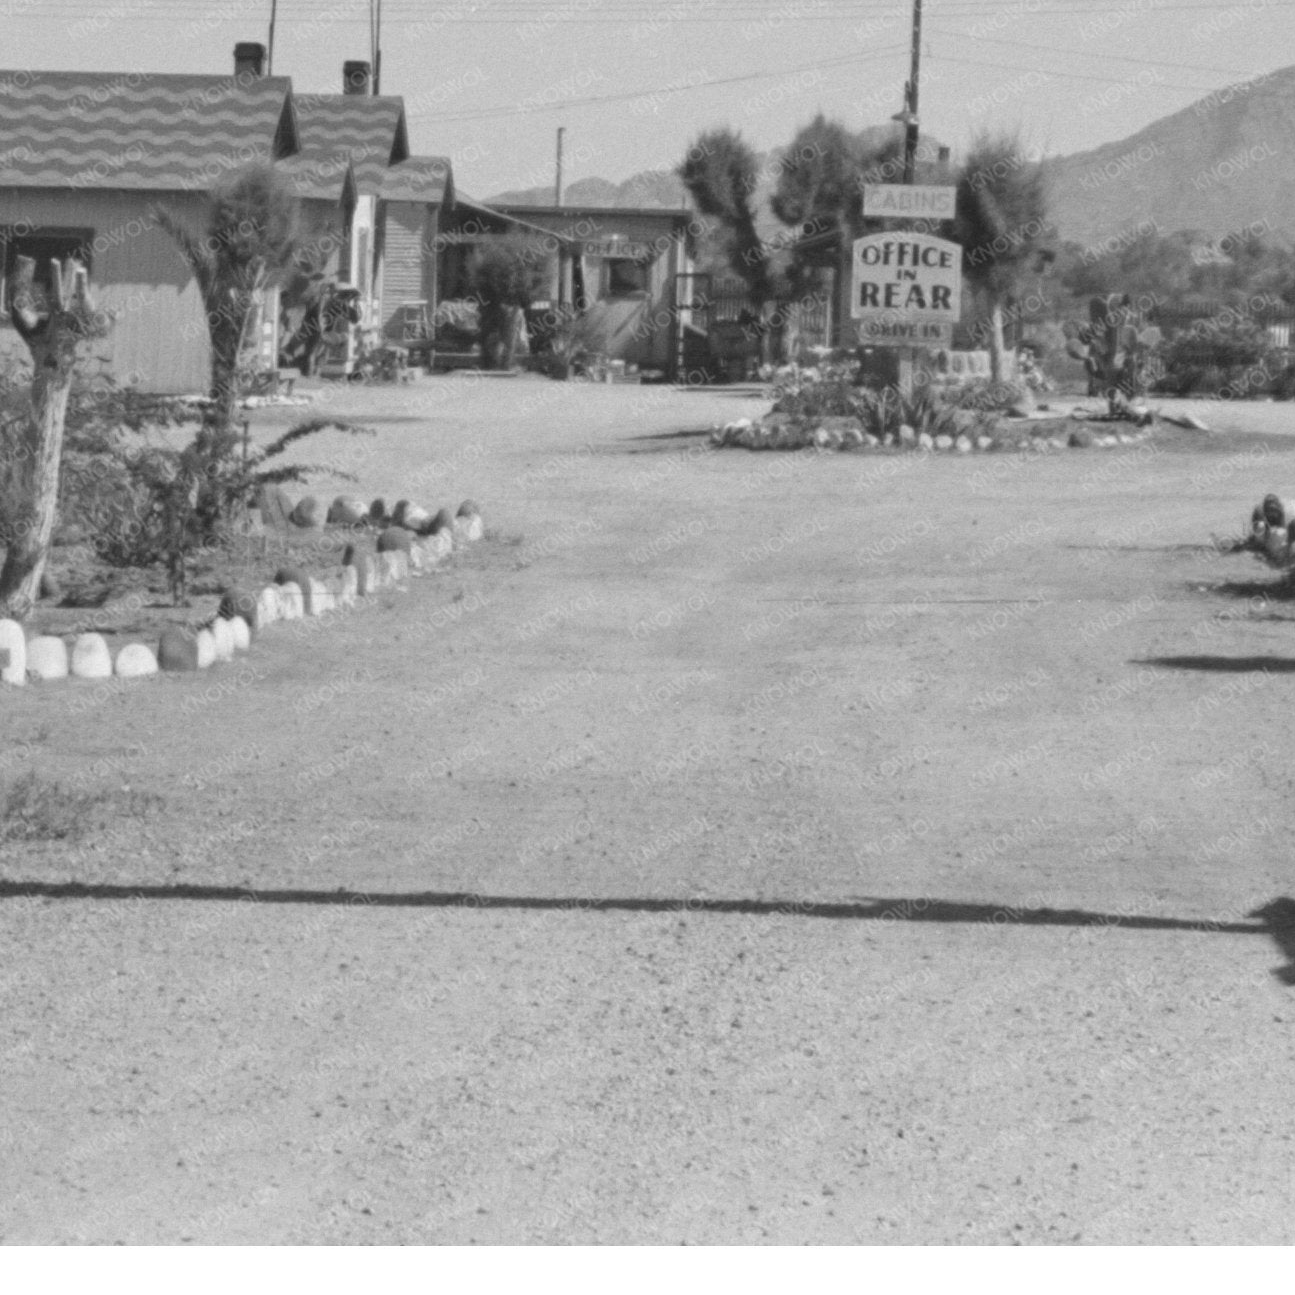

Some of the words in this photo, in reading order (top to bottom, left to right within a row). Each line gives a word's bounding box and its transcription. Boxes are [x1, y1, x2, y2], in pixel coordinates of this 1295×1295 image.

[861, 240, 954, 269] OFFICE
[896, 268, 918, 282] IN
[860, 281, 952, 311] REAR
